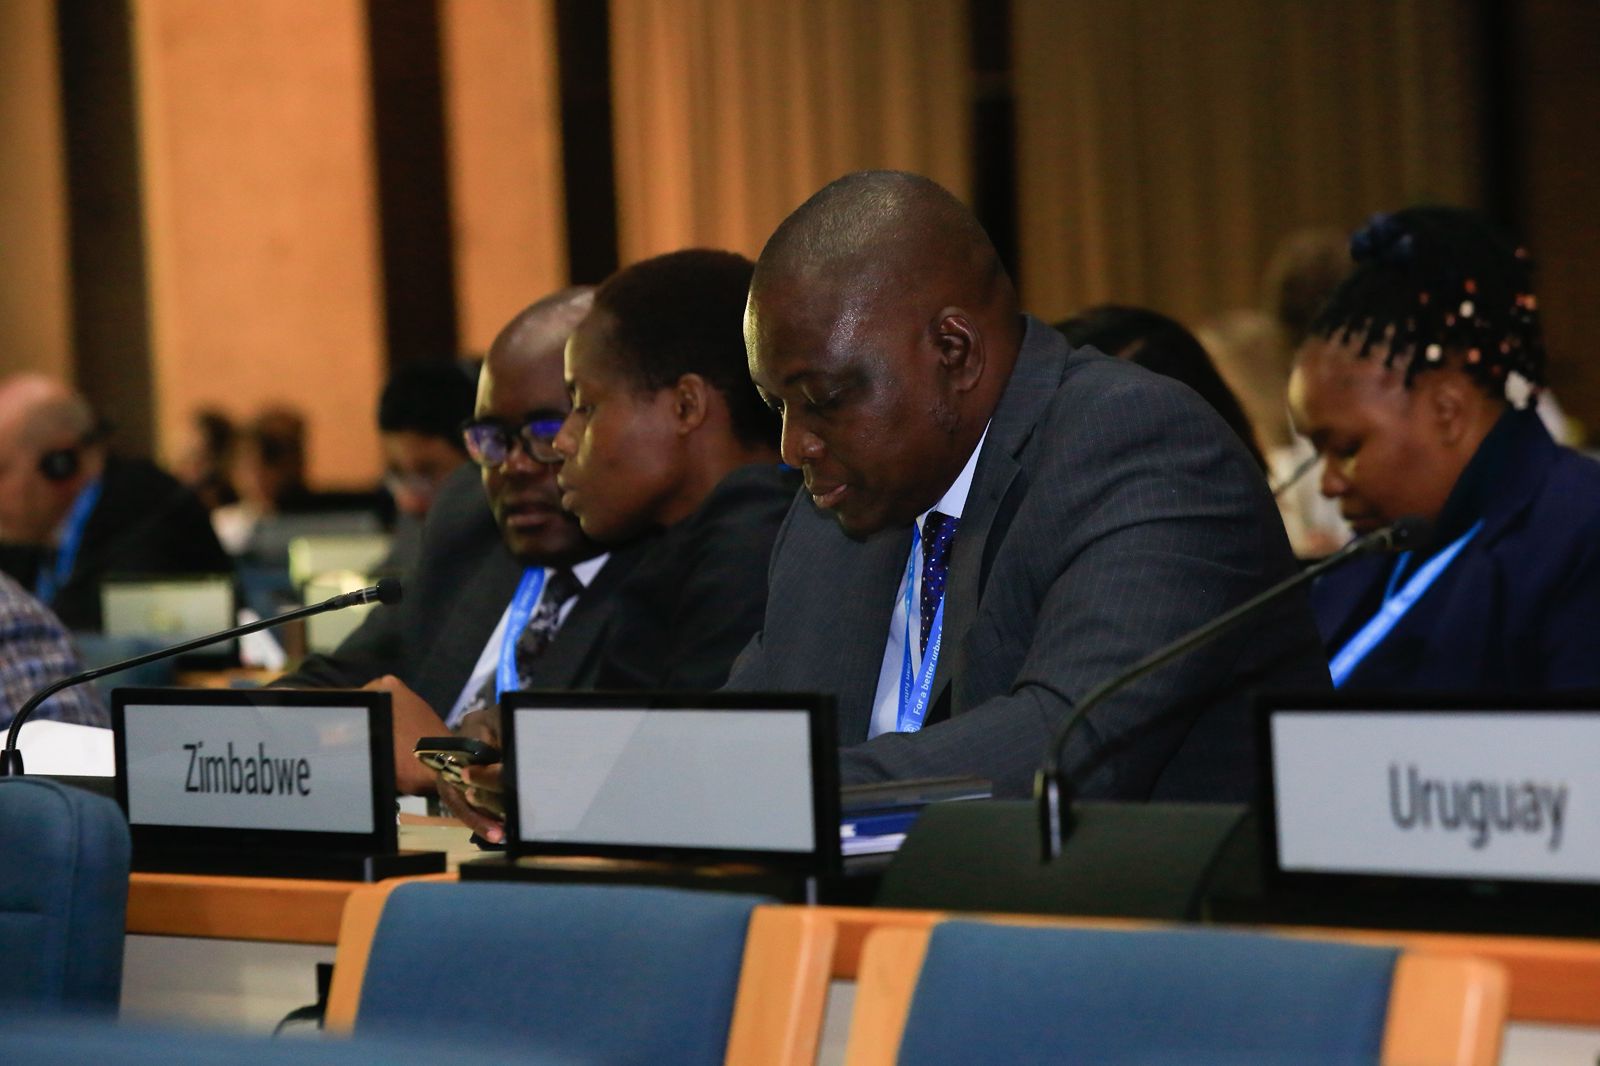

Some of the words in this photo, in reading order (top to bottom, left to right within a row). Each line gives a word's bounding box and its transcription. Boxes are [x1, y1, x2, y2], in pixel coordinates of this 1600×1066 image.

[913, 699, 924, 715] For
[921, 662, 935, 690] better
[183, 741, 310, 796] Zimbabwe
[1388, 762, 1569, 852] Uruguay
